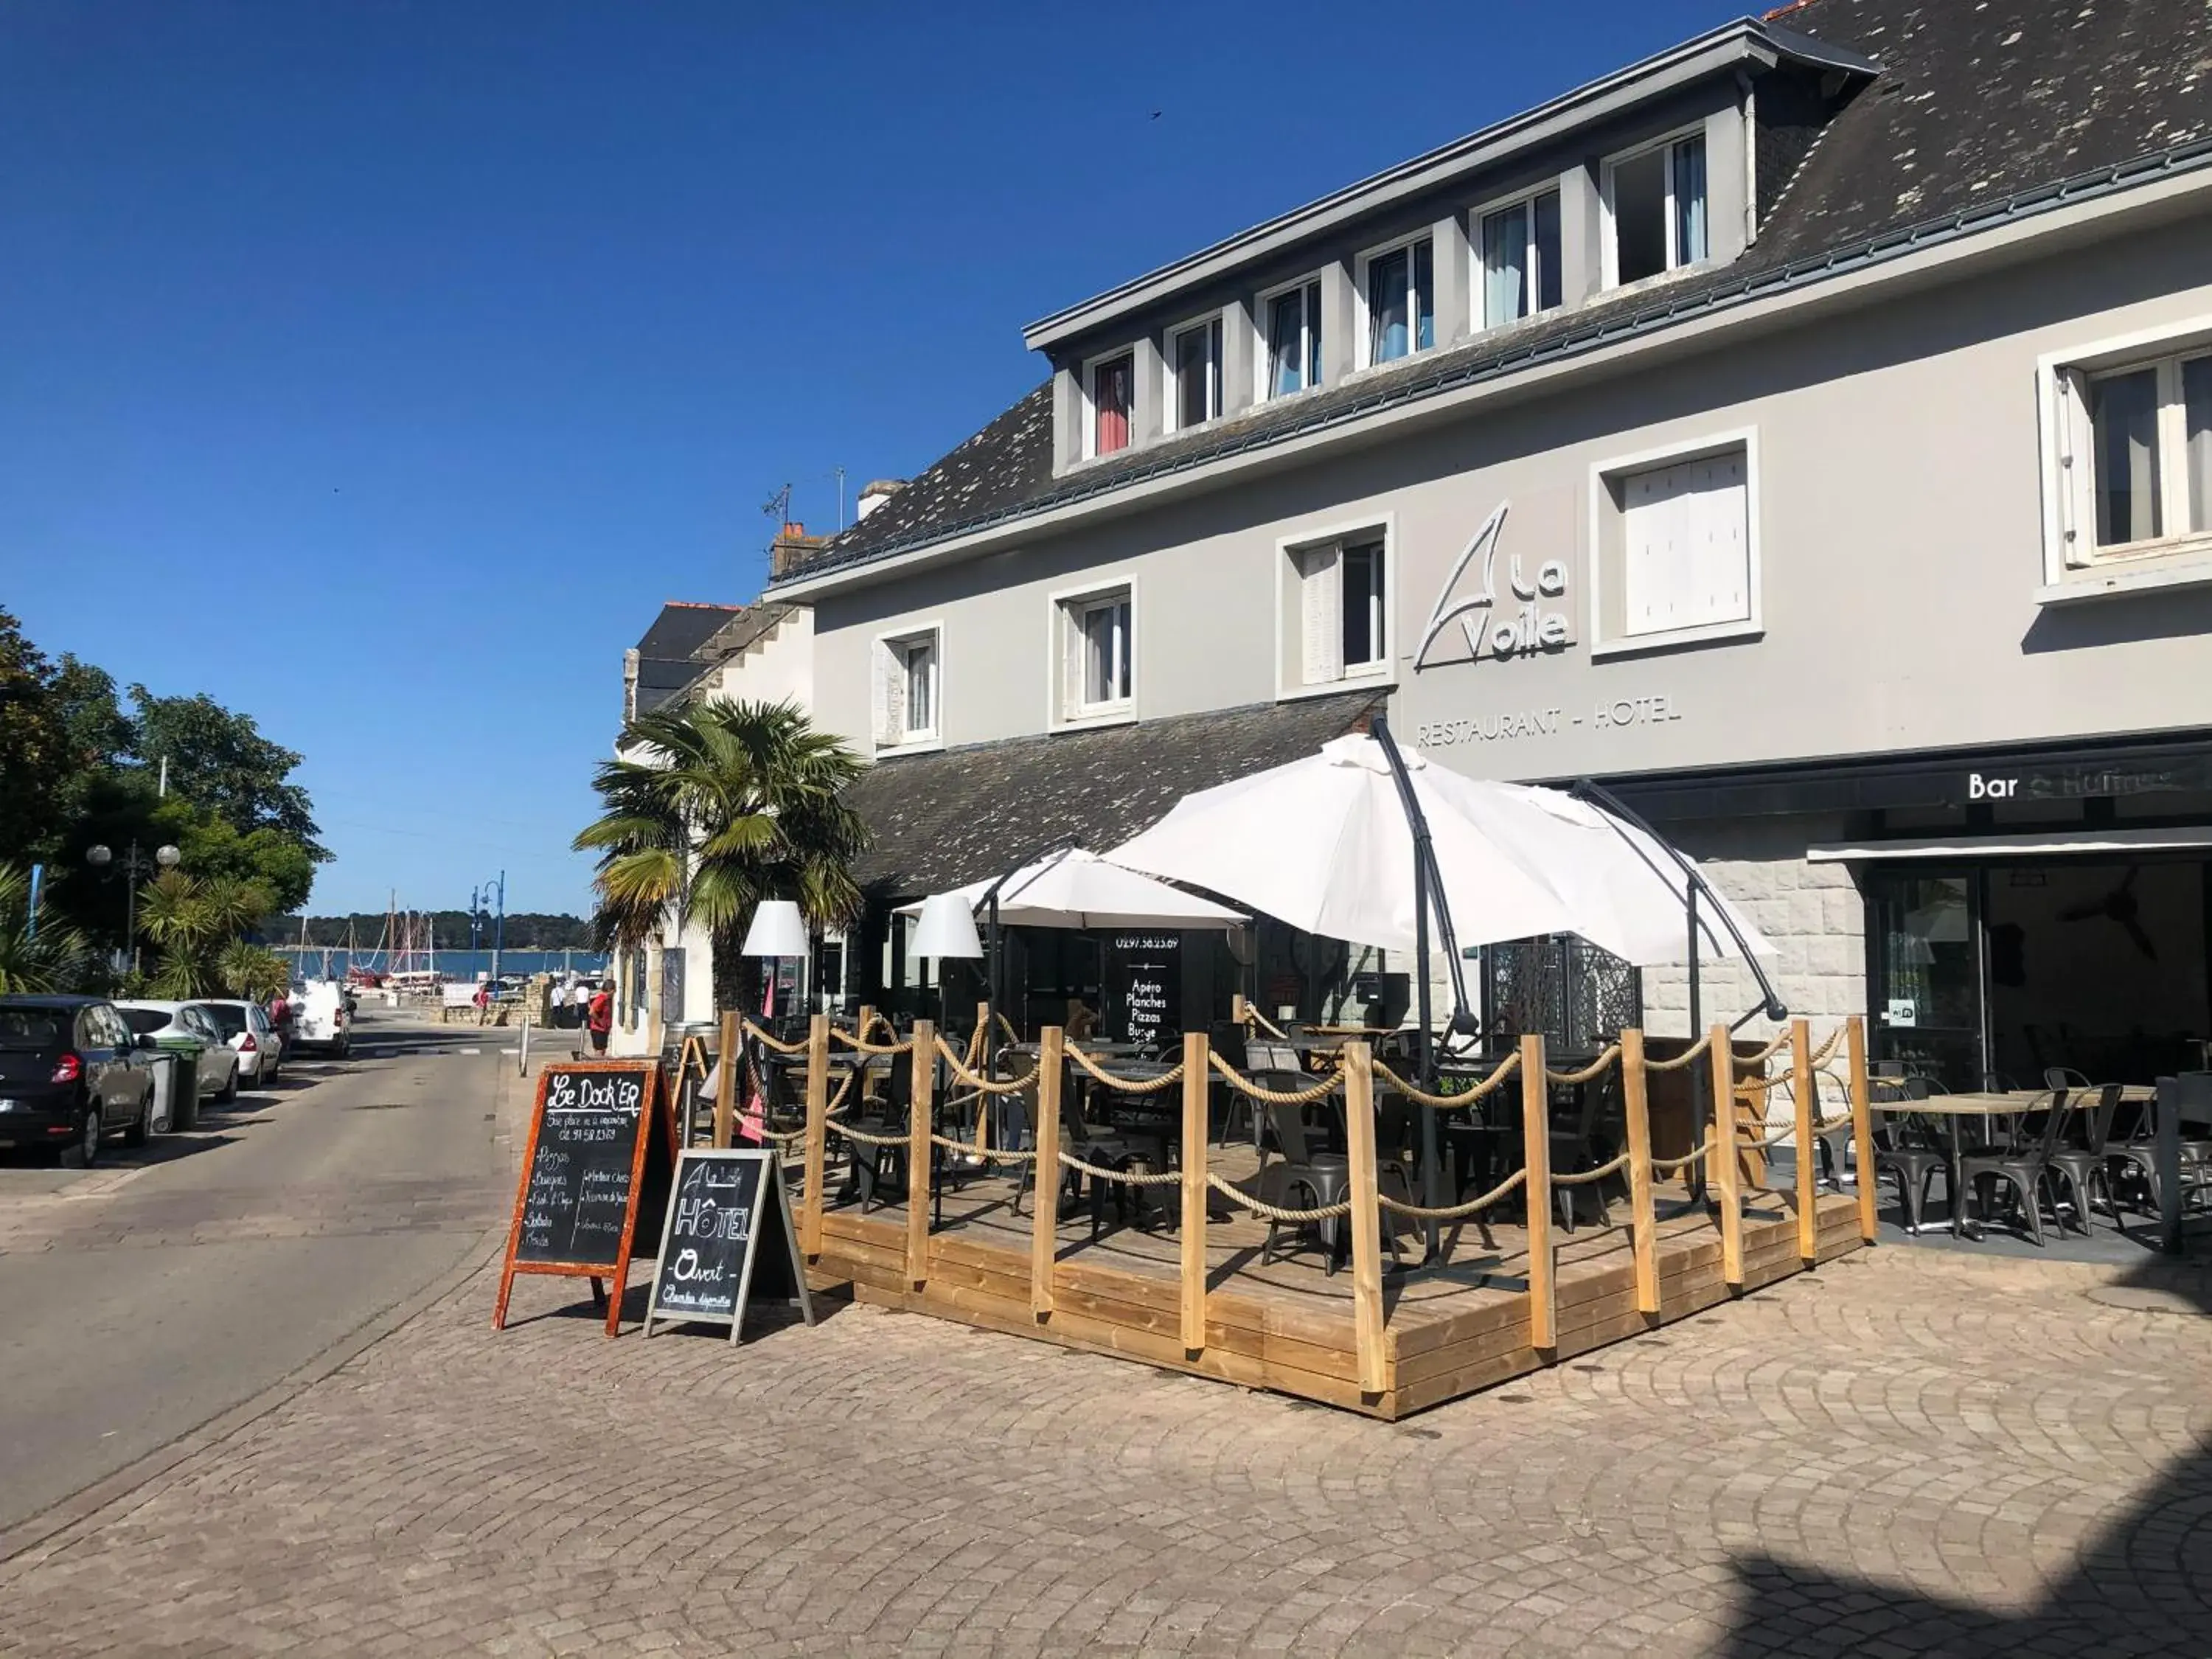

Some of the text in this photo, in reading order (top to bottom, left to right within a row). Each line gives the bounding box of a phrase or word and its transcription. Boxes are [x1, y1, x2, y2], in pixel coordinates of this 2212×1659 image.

[1509, 554, 1568, 599] La
[1461, 602, 1568, 660] Voile
[1417, 708, 1562, 748] RESTAURANT
[1594, 695, 1682, 729] HOTEL
[1969, 773, 2018, 799] Bar
[1126, 993, 1166, 1008] Planches
[1132, 979, 1161, 995] Apéro
[1132, 1008, 1161, 1023] Pizzas
[1127, 1023, 1157, 1041] Burge
[547, 1074, 576, 1108] Le
[675, 1197, 749, 1240] HÔTEL
